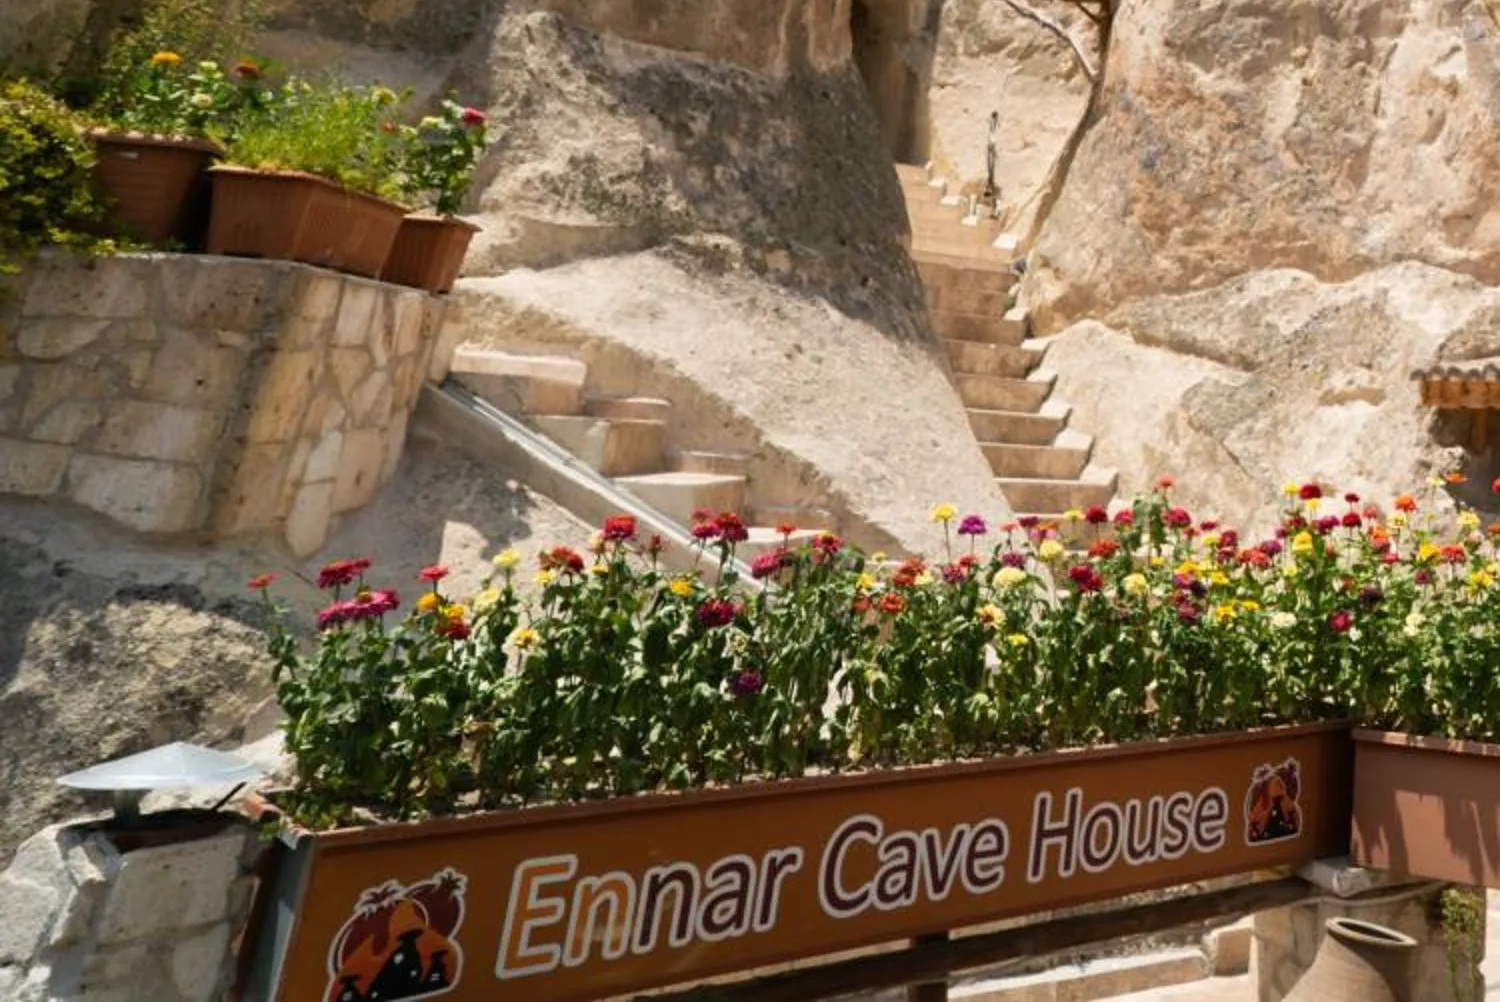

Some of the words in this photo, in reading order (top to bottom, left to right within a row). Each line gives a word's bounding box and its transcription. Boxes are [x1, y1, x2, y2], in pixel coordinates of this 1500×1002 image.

[496, 846, 803, 979] Ennar
[818, 813, 1009, 918] Cave
[1026, 786, 1229, 883] House
